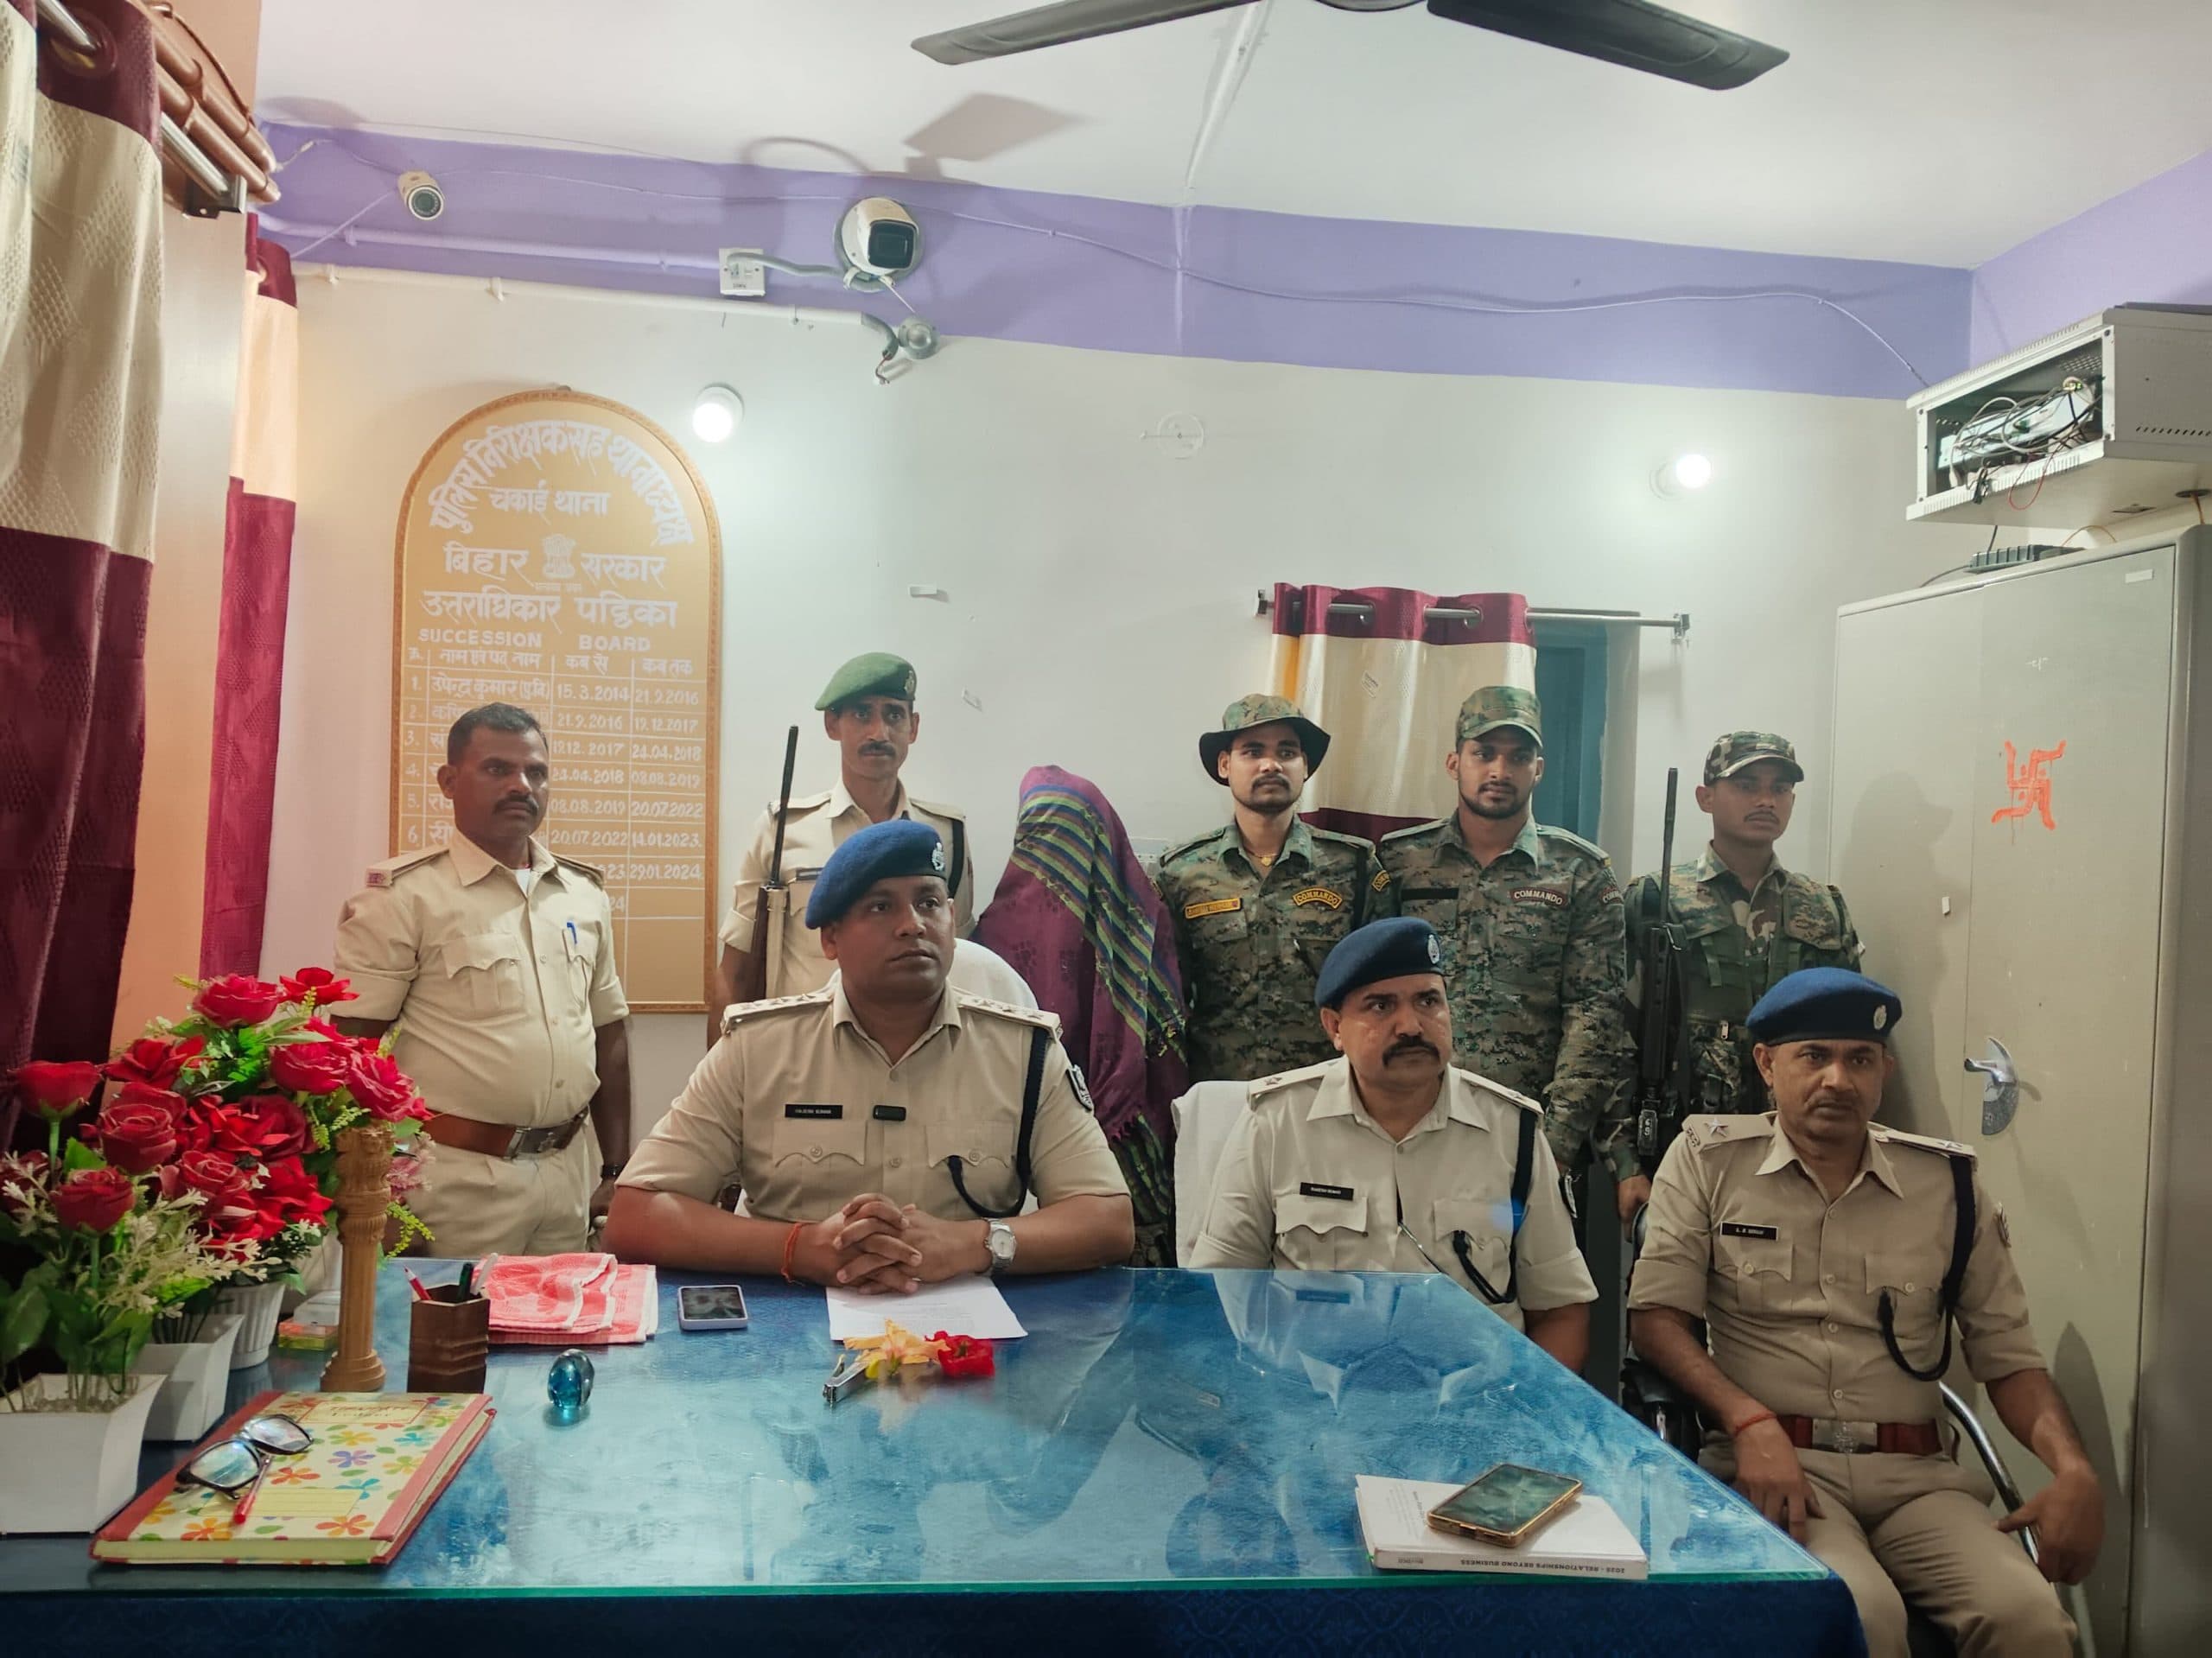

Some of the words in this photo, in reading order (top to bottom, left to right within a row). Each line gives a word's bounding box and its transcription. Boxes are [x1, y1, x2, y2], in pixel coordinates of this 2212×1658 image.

[489, 479, 550, 525] चकाई
[554, 490, 611, 516] थाना
[442, 540, 534, 587] बिहार
[580, 552, 666, 589] सरकार
[419, 584, 562, 634] उत्तराधिकार
[418, 628, 543, 648] SUCCESSION
[578, 634, 651, 651] BOARD
[1296, 891, 1338, 905] COMMANDO
[1514, 889, 1563, 905] COMMANDO
[1501, 1560, 1534, 1569] BEYOND
[1536, 1562, 1599, 1572] RELATIONSHIPS
